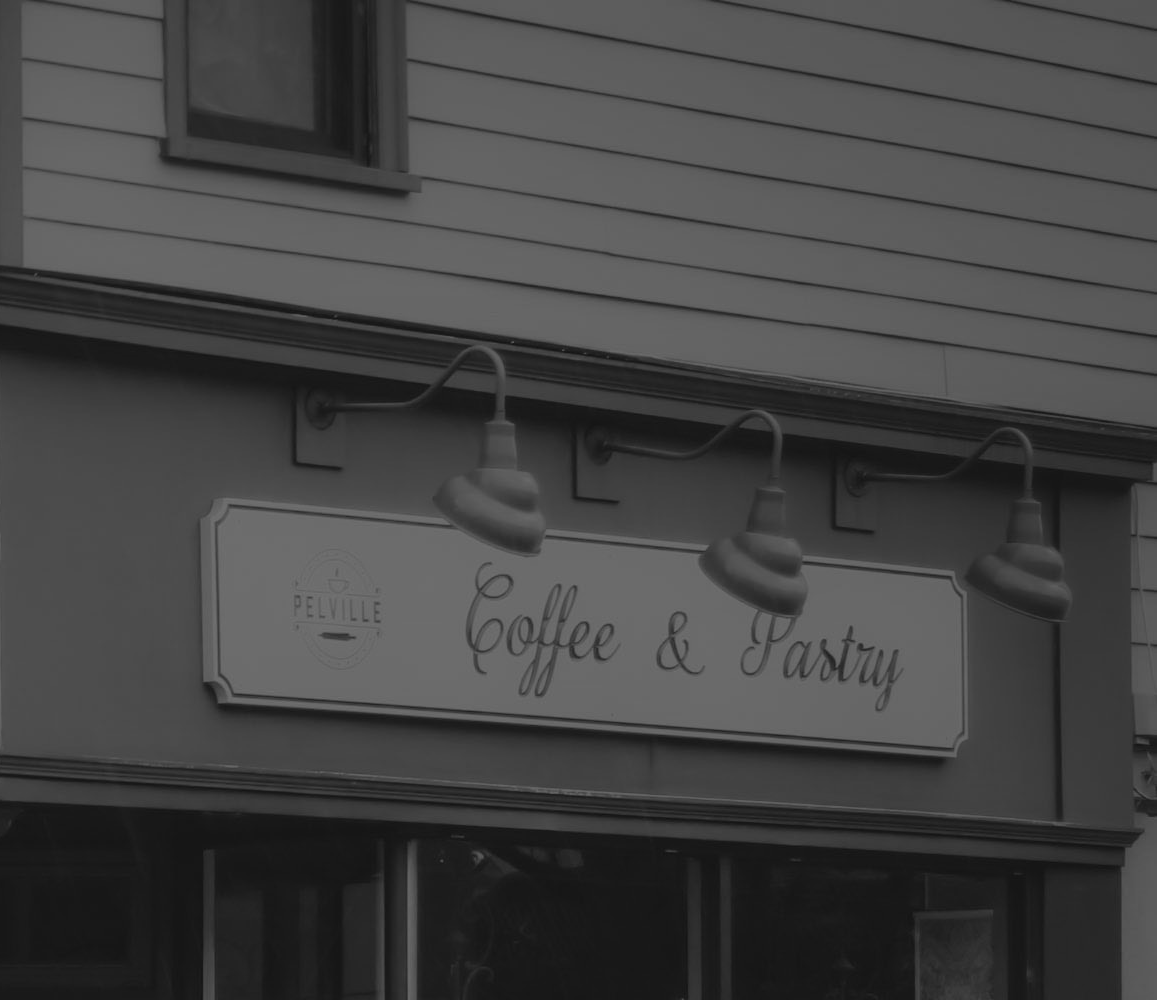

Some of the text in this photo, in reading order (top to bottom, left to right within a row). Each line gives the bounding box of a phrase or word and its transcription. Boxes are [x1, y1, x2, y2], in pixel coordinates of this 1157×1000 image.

[293, 594, 382, 624] PELVILLE
[465, 561, 905, 713] Coffee & Pastry
